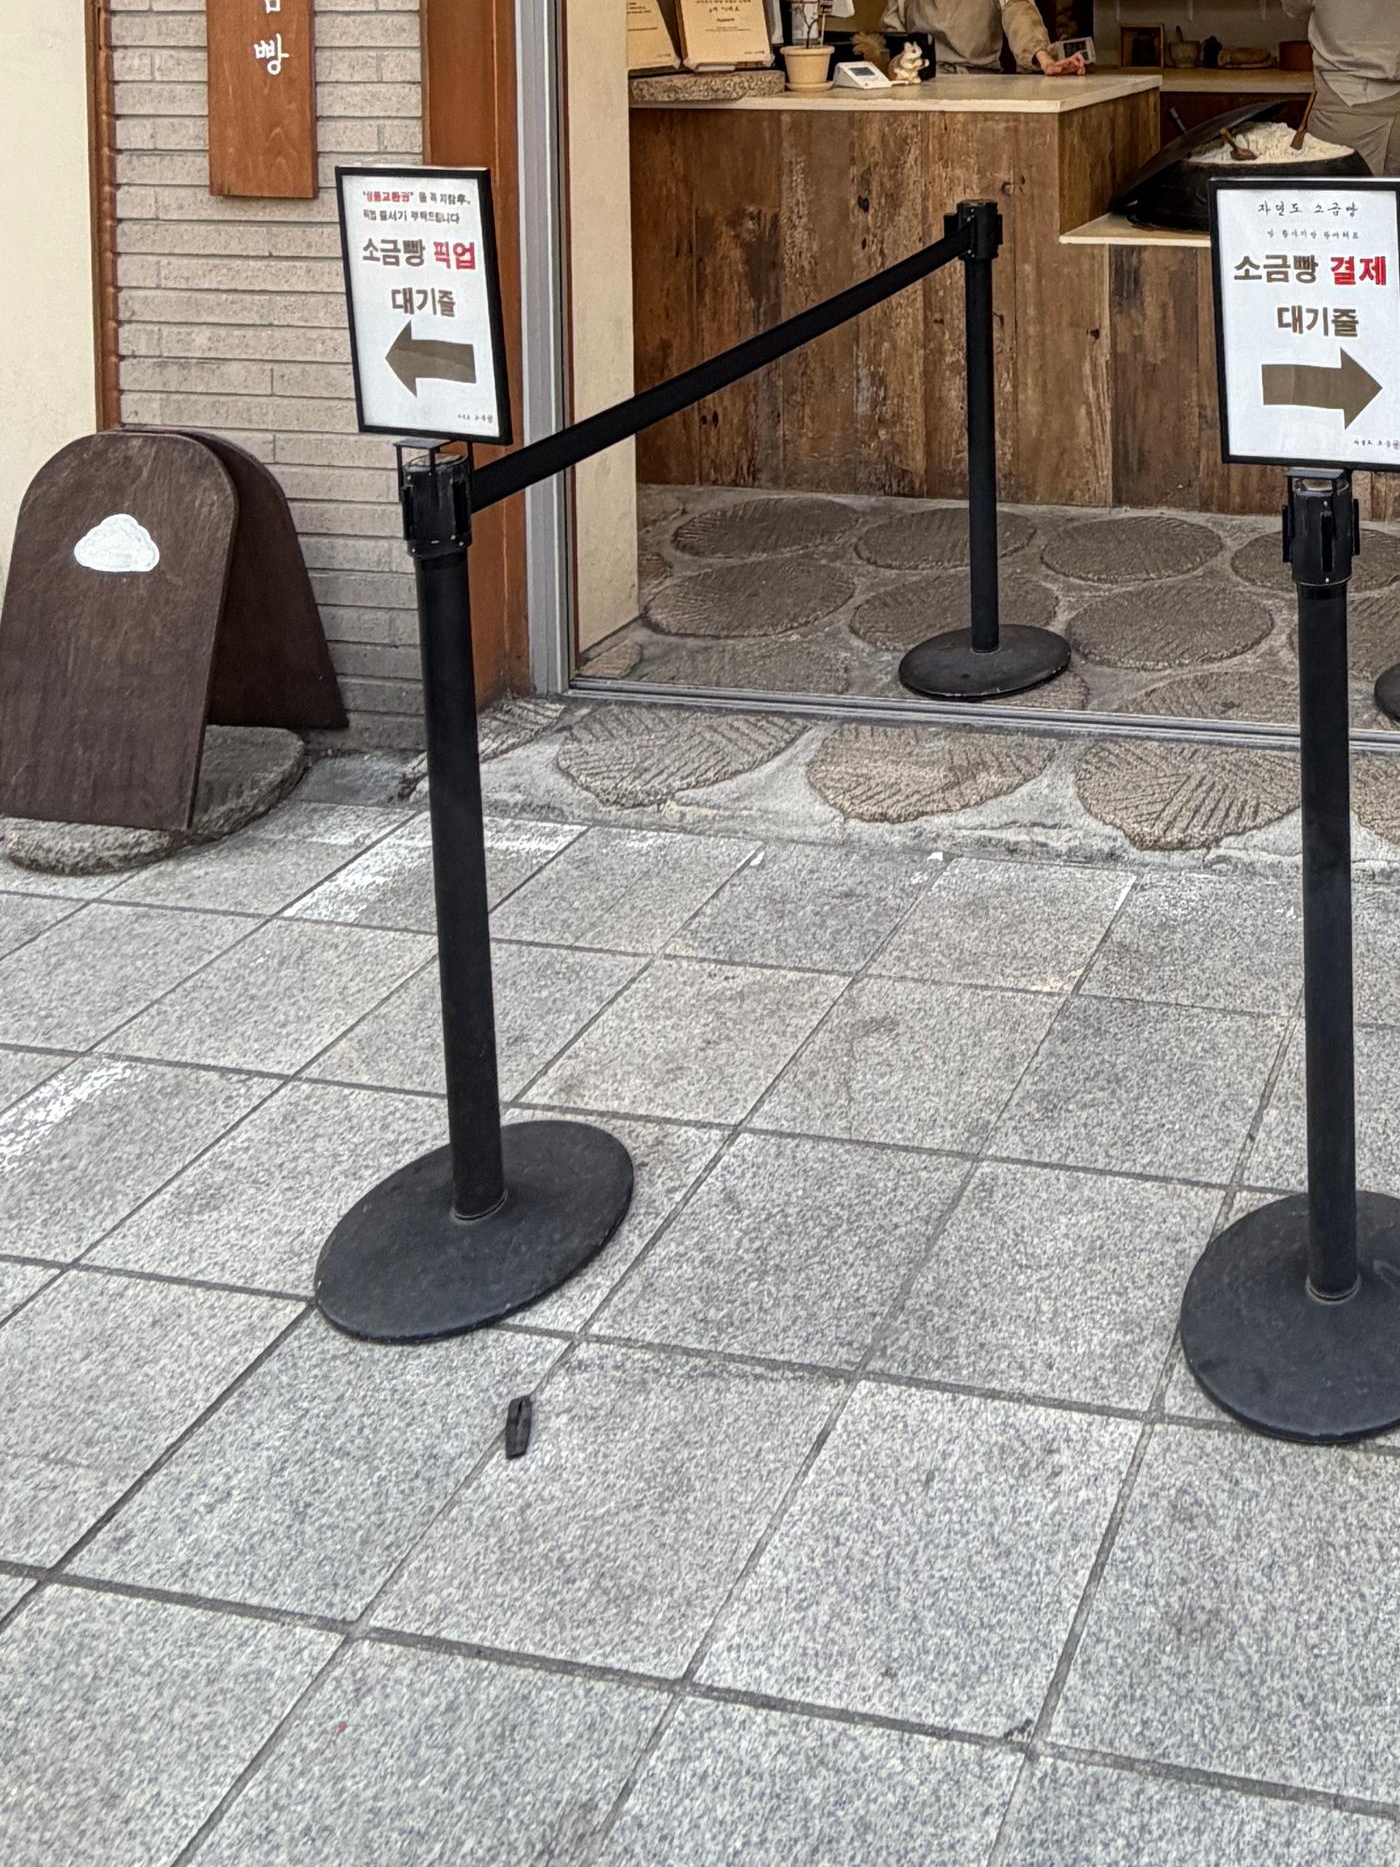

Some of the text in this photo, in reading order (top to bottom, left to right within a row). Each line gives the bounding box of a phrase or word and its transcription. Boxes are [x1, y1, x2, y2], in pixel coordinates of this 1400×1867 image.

[1258, 200, 1358, 217] 자연도 소금빵
[362, 237, 476, 270] 소금빵 픽업
[1233, 254, 1388, 286] 소금빵 결제
[391, 287, 457, 317] 대기줄
[1277, 305, 1360, 337] 대기줄
